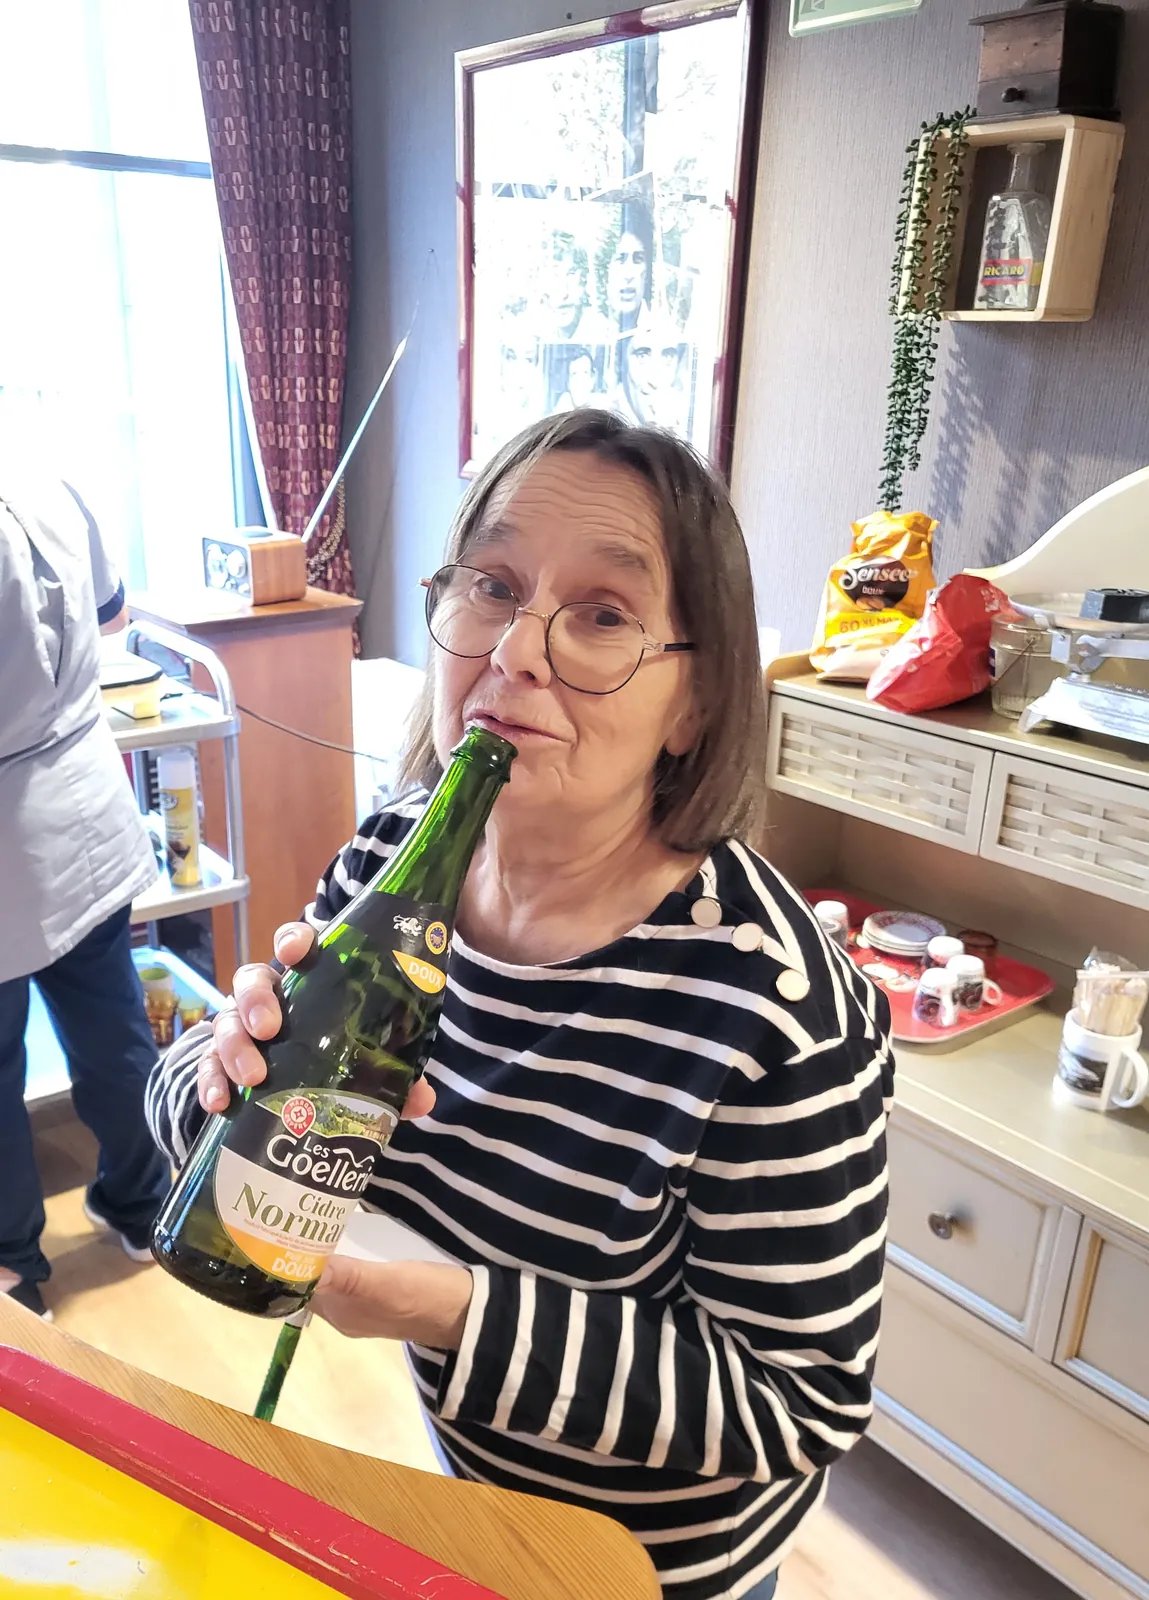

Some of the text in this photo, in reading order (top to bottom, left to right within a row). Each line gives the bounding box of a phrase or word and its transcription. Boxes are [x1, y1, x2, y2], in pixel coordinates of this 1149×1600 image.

[983, 264, 1025, 276] RICARD
[840, 620, 859, 633] 60
[408, 961, 443, 987] DOUX
[303, 1136, 330, 1158] Les
[298, 1193, 345, 1220] Cidre
[272, 1257, 316, 1279] DOUX
